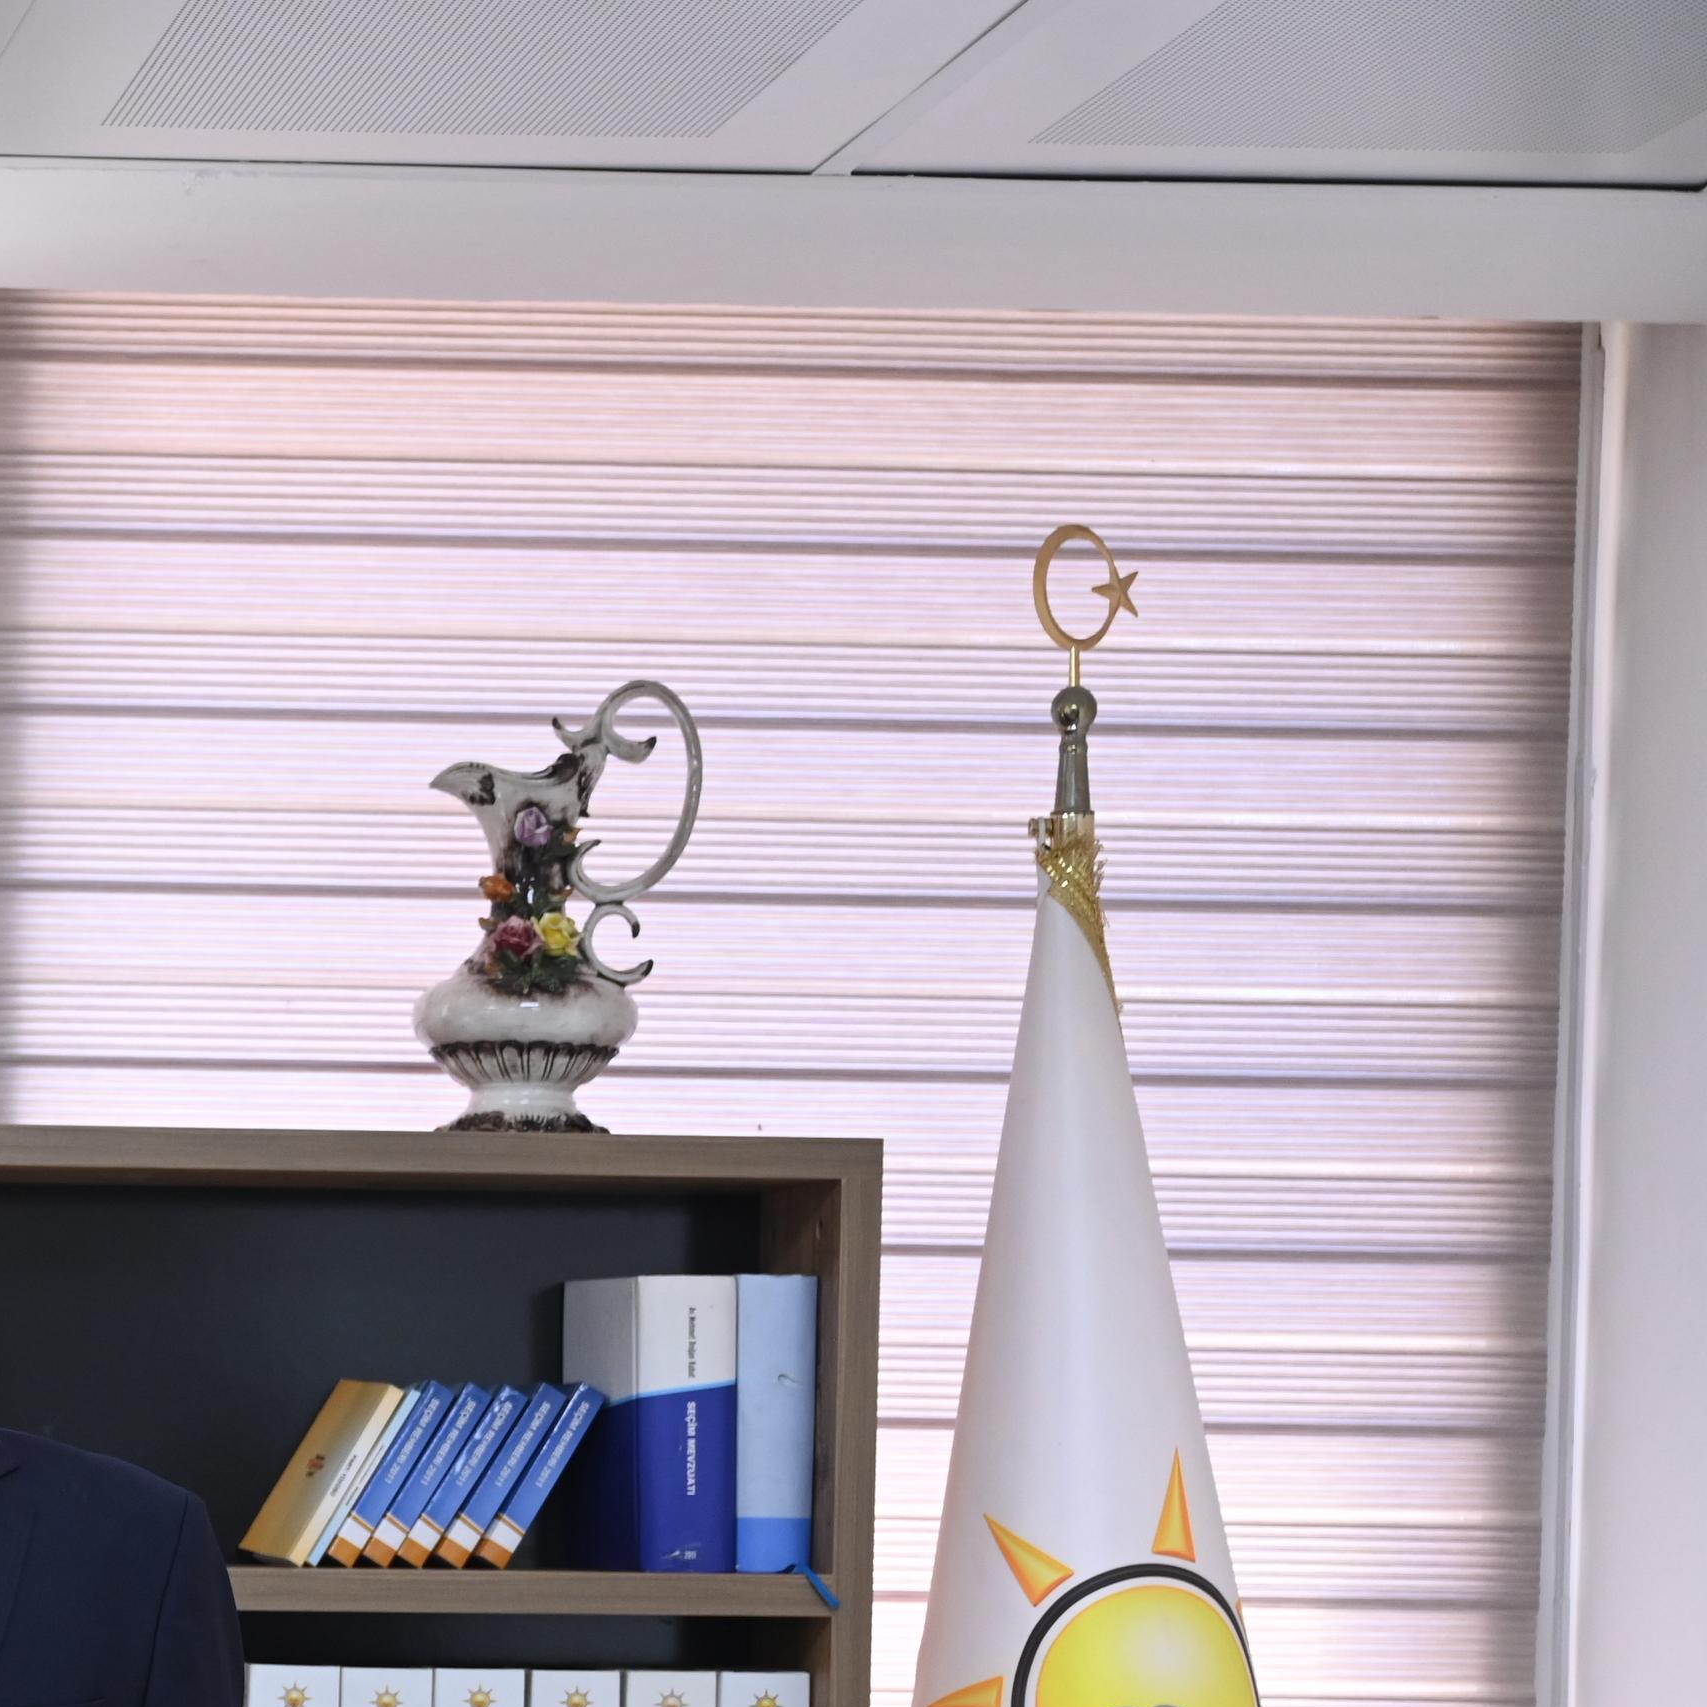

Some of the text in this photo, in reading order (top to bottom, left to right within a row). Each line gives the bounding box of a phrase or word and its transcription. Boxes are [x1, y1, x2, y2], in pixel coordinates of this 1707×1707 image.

[419, 1397, 440, 1428] SEÇİM
[455, 1398, 476, 1430] SEÇİM
[491, 1400, 513, 1431] SEÇİM
[530, 1400, 551, 1431] SEÇİM
[569, 1400, 589, 1431] SEÇİM
[684, 1401, 698, 1495] SEÇİM MEVZUATI
[384, 1462, 402, 1485] 2011
[420, 1464, 437, 1486] 2011
[456, 1465, 472, 1487] 2011
[494, 1466, 510, 1488] 2011
[535, 1466, 552, 1488] 2011
